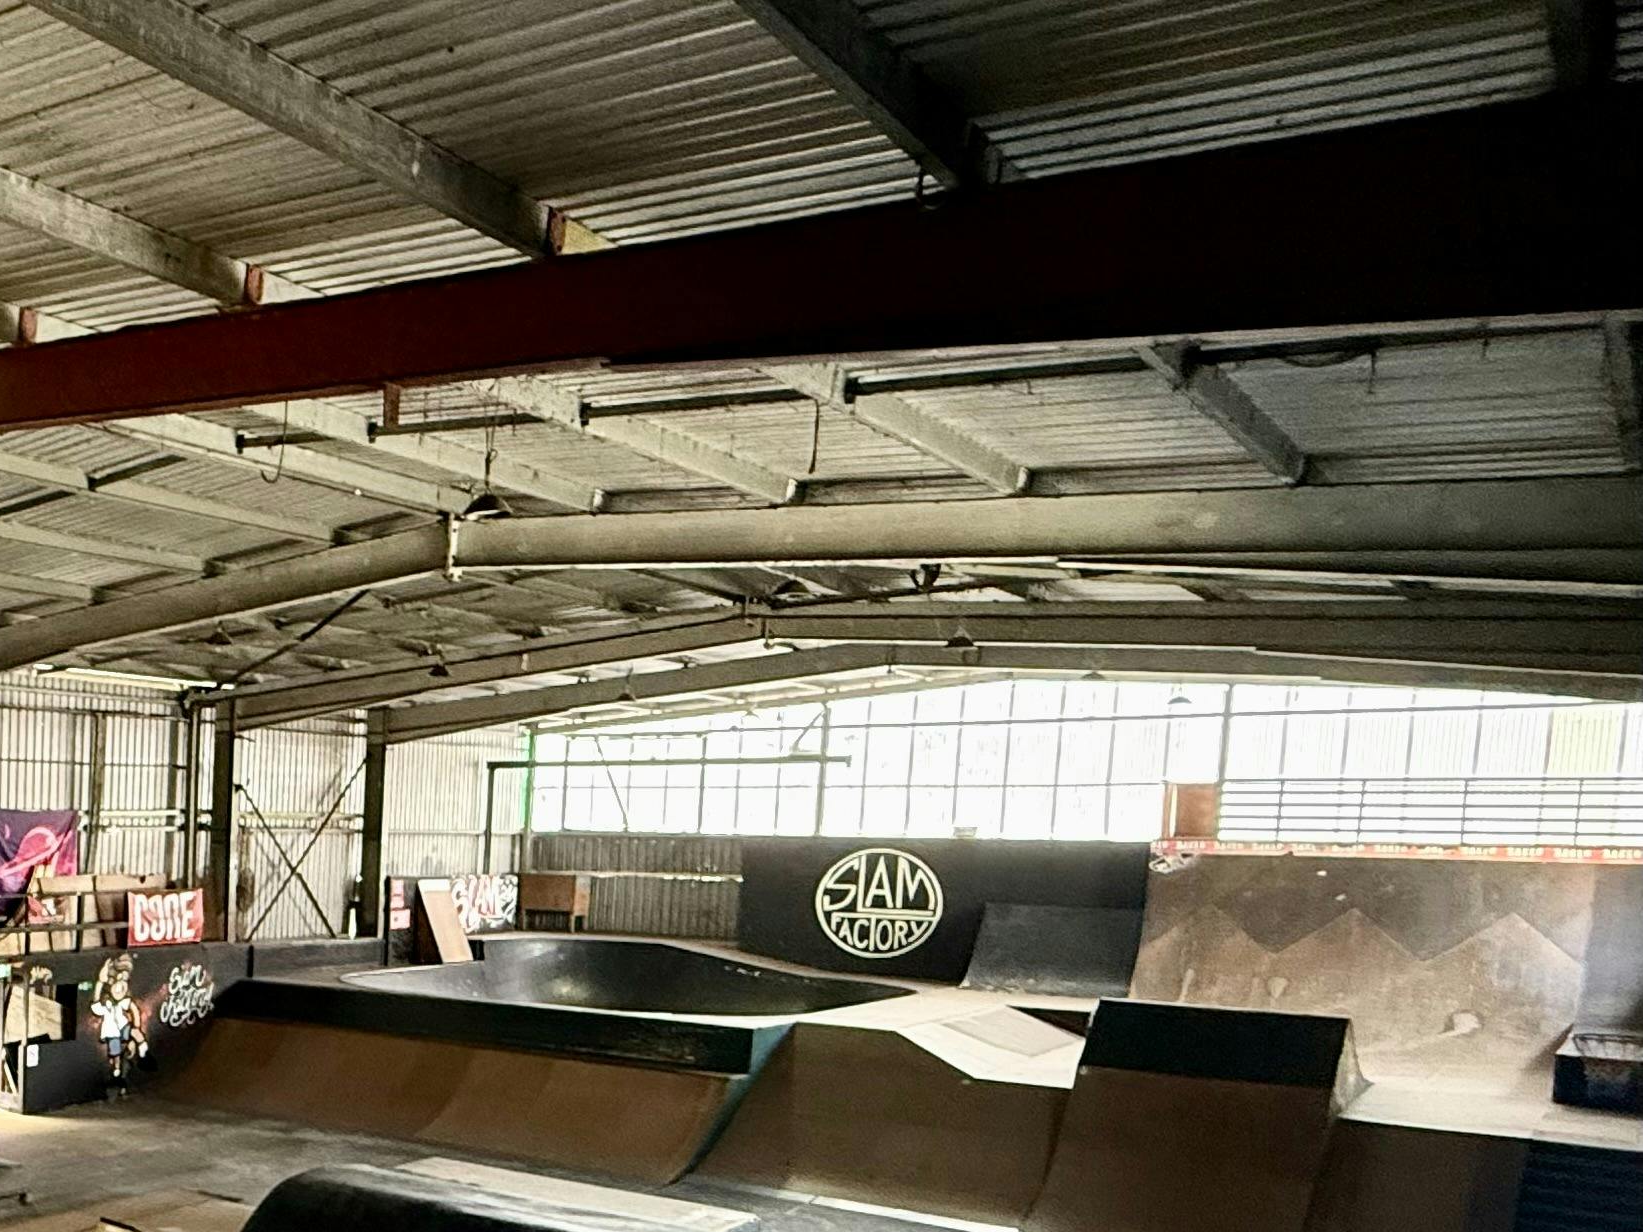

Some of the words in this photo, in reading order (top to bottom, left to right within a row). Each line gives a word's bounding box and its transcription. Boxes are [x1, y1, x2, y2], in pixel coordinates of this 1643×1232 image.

[822, 853, 936, 915] SLAM
[134, 891, 197, 943] CORE
[831, 912, 934, 951] FACTORY
